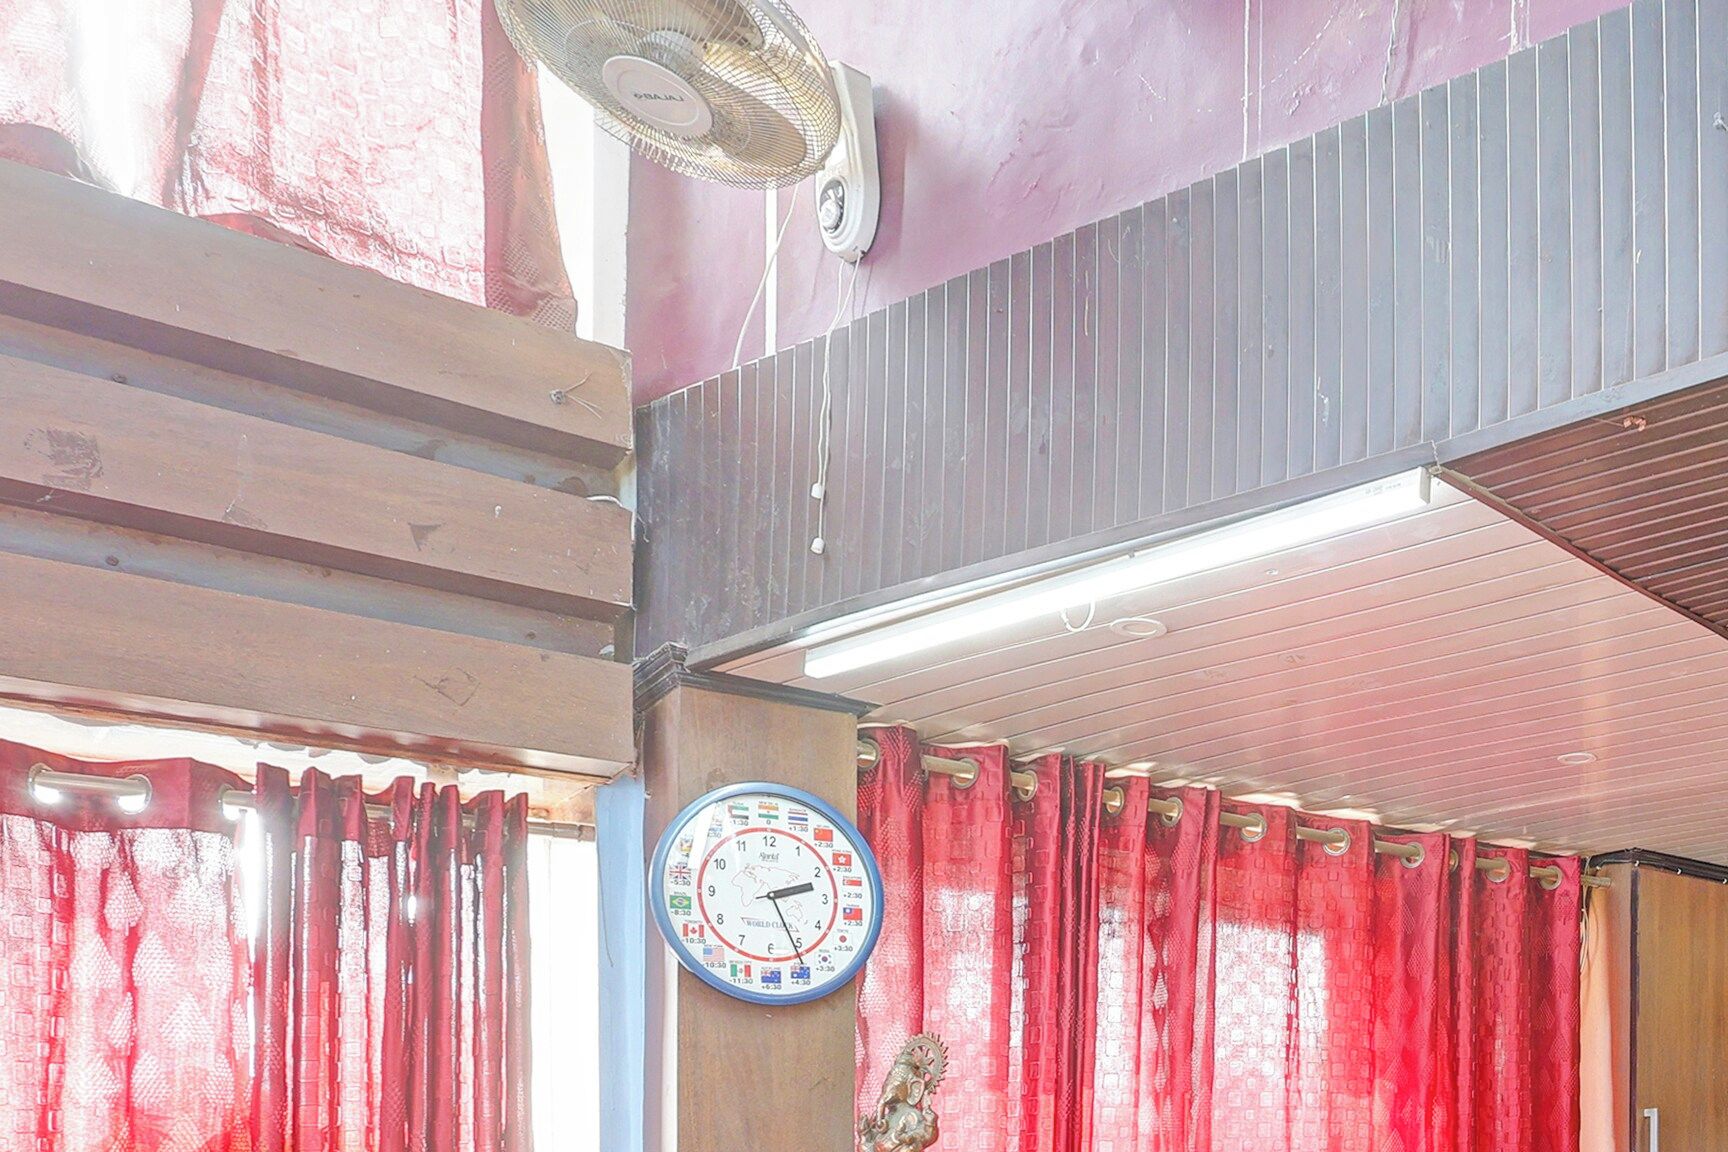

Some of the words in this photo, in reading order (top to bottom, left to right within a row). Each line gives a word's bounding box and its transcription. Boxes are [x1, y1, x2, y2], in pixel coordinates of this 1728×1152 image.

[736, 840, 747, 852] 11
[762, 836, 777, 848] 12
[795, 846, 801, 857] 1
[713, 858, 727, 870] 10
[814, 866, 821, 878] 2
[708, 885, 716, 897] 9
[821, 893, 829, 905] 3
[716, 913, 724, 925] 8
[747, 920, 771, 928] WORLD
[771, 921, 794, 930] CLOK
[814, 919, 822, 931] 4
[738, 934, 746, 946] 7
[795, 937, 803, 949] 5
[767, 943, 775, 955] 6
